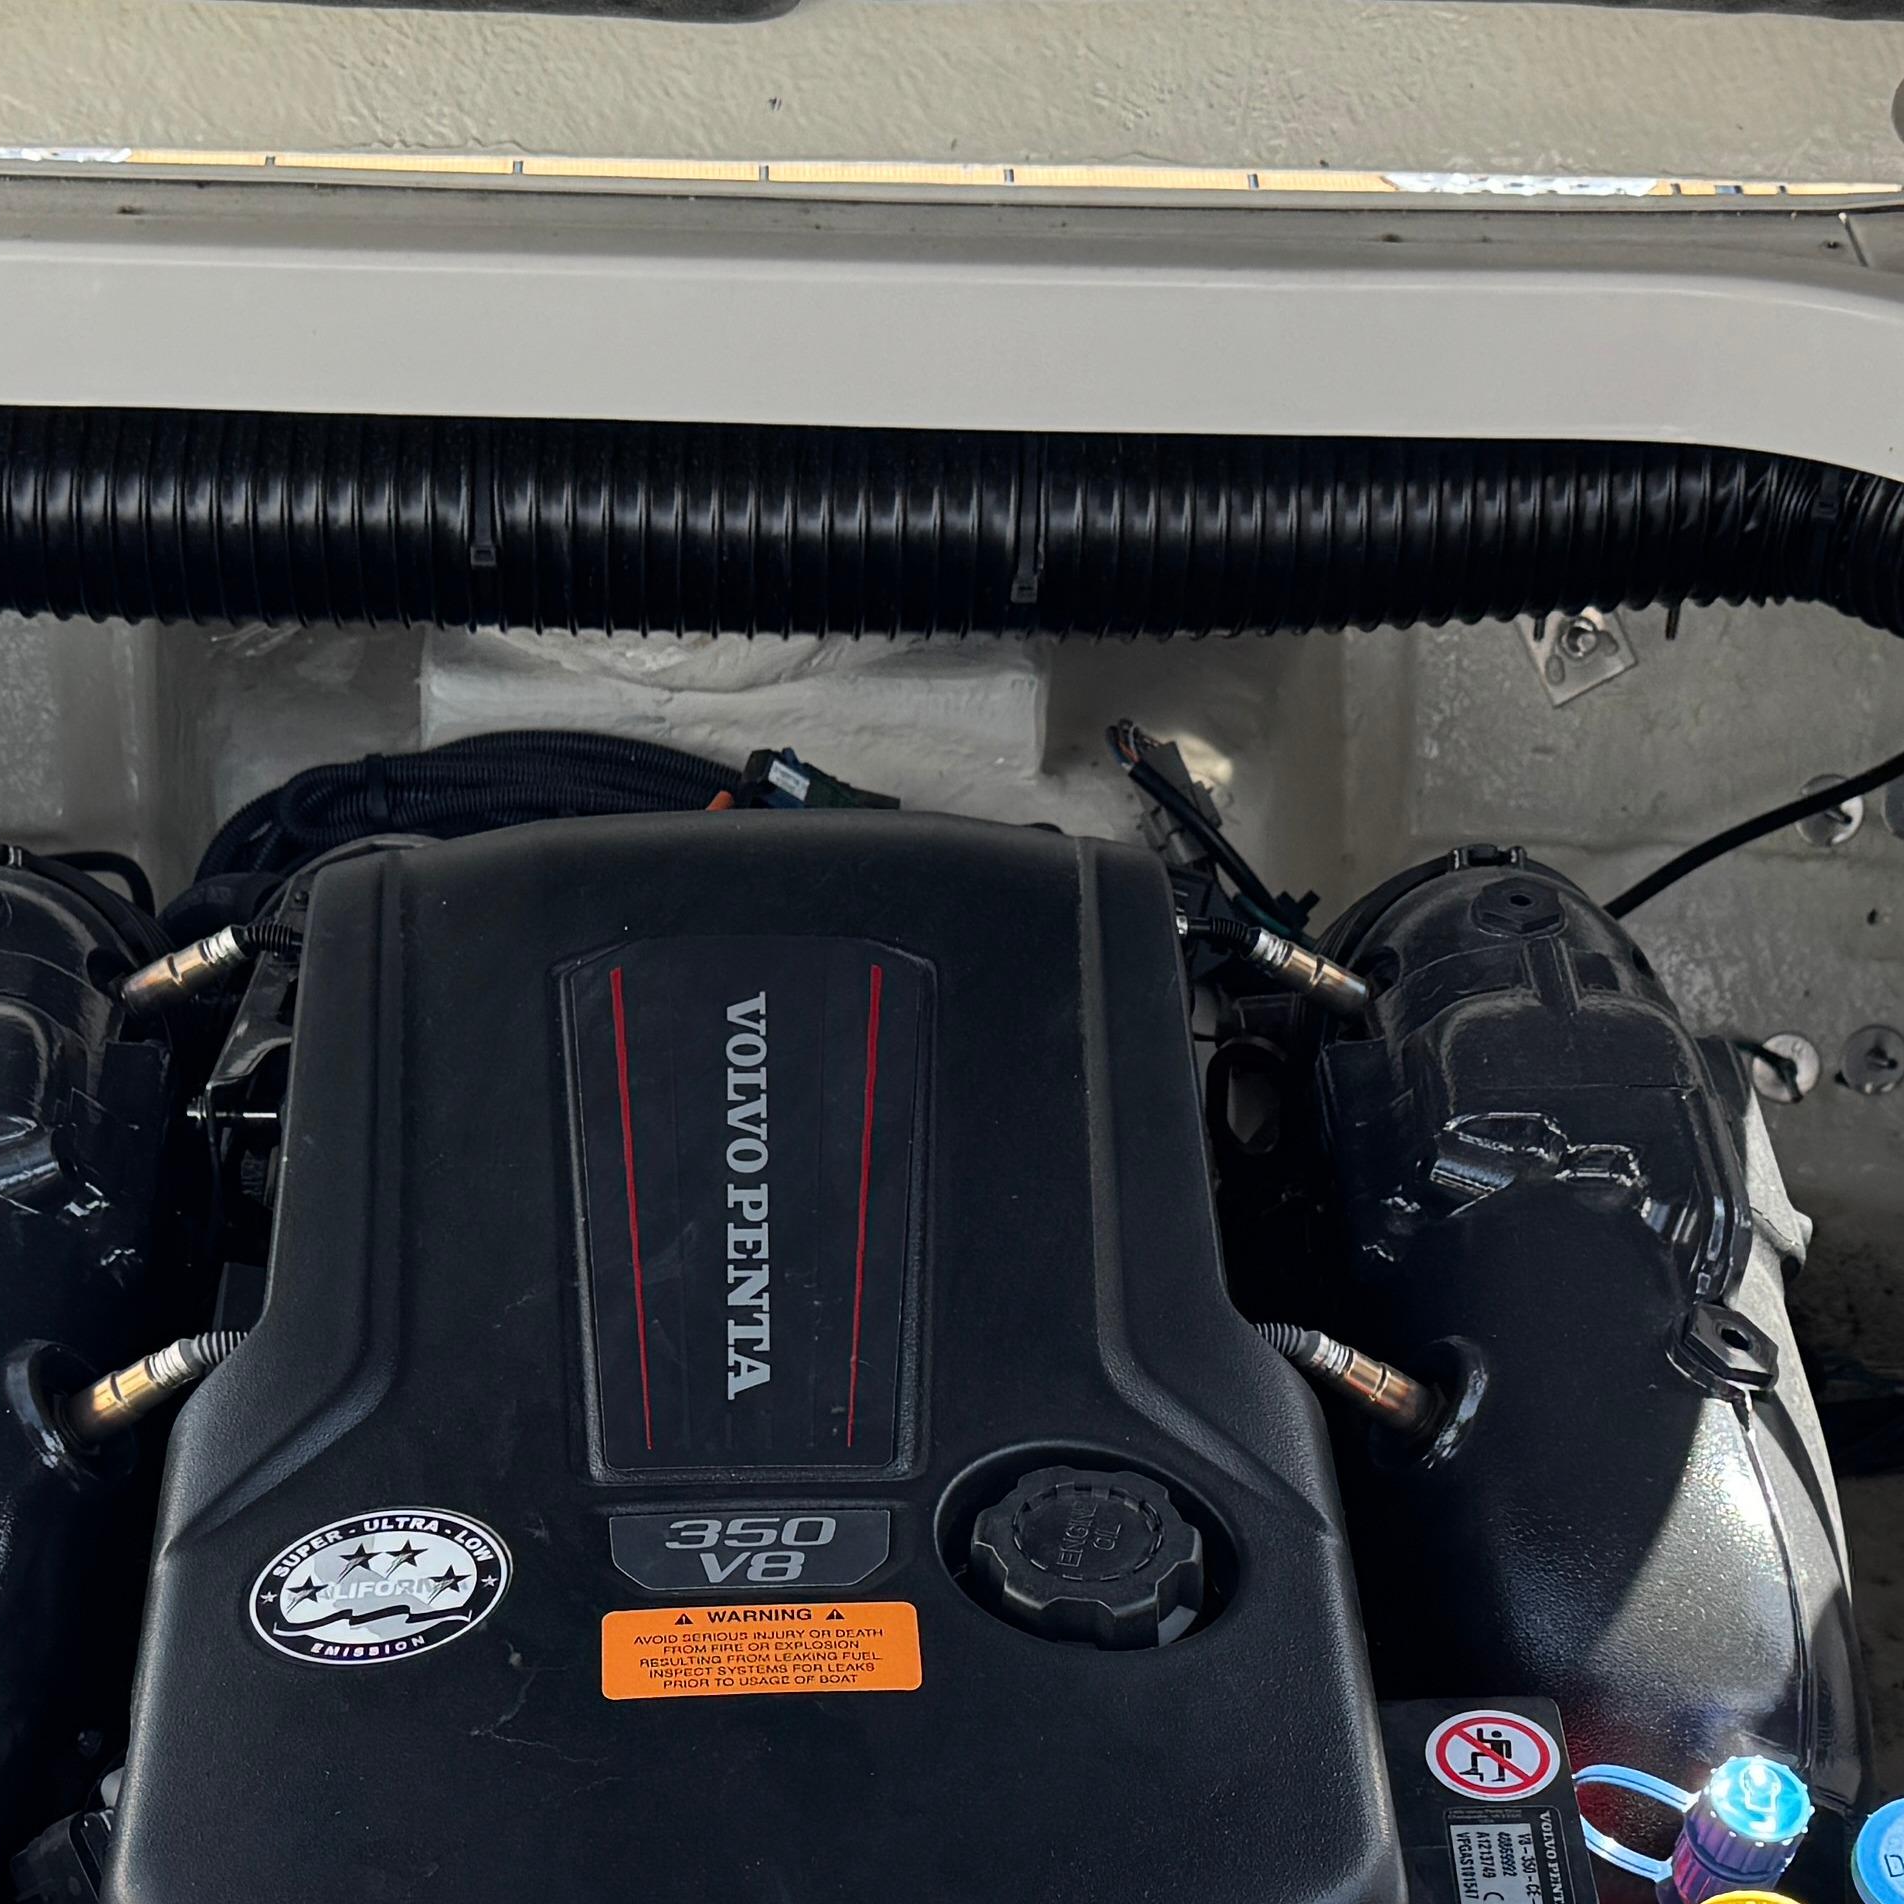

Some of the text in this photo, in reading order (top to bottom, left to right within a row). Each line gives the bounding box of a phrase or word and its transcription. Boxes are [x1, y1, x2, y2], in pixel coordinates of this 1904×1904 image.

[725, 991, 771, 1400] VOLVO PENTA
[665, 1516, 837, 1550] 350
[273, 1517, 495, 1578] SUPER ULTRA LOW
[699, 1551, 805, 1583] V8
[707, 1608, 812, 1624] WARNING
[310, 1635, 426, 1657] EMISSION
[634, 1628, 883, 1645] AVOID SERIOUS INJURY OR DEATH
[663, 1640, 860, 1655] FROM FIRE OR EXPLOSION
[640, 1655, 722, 1667] RESULTING
[726, 1653, 771, 1663] FROM
[774, 1652, 838, 1662] LEAKING
[649, 1661, 875, 1678] INSPECT SYSTEMS FOR LEAKS
[663, 1678, 709, 1689] PRIOR
[714, 1677, 734, 1687] TO
[794, 1674, 816, 1684] OF
[820, 1672, 858, 1683] BOAT
[1539, 1810, 1557, 1863] VOLVO
